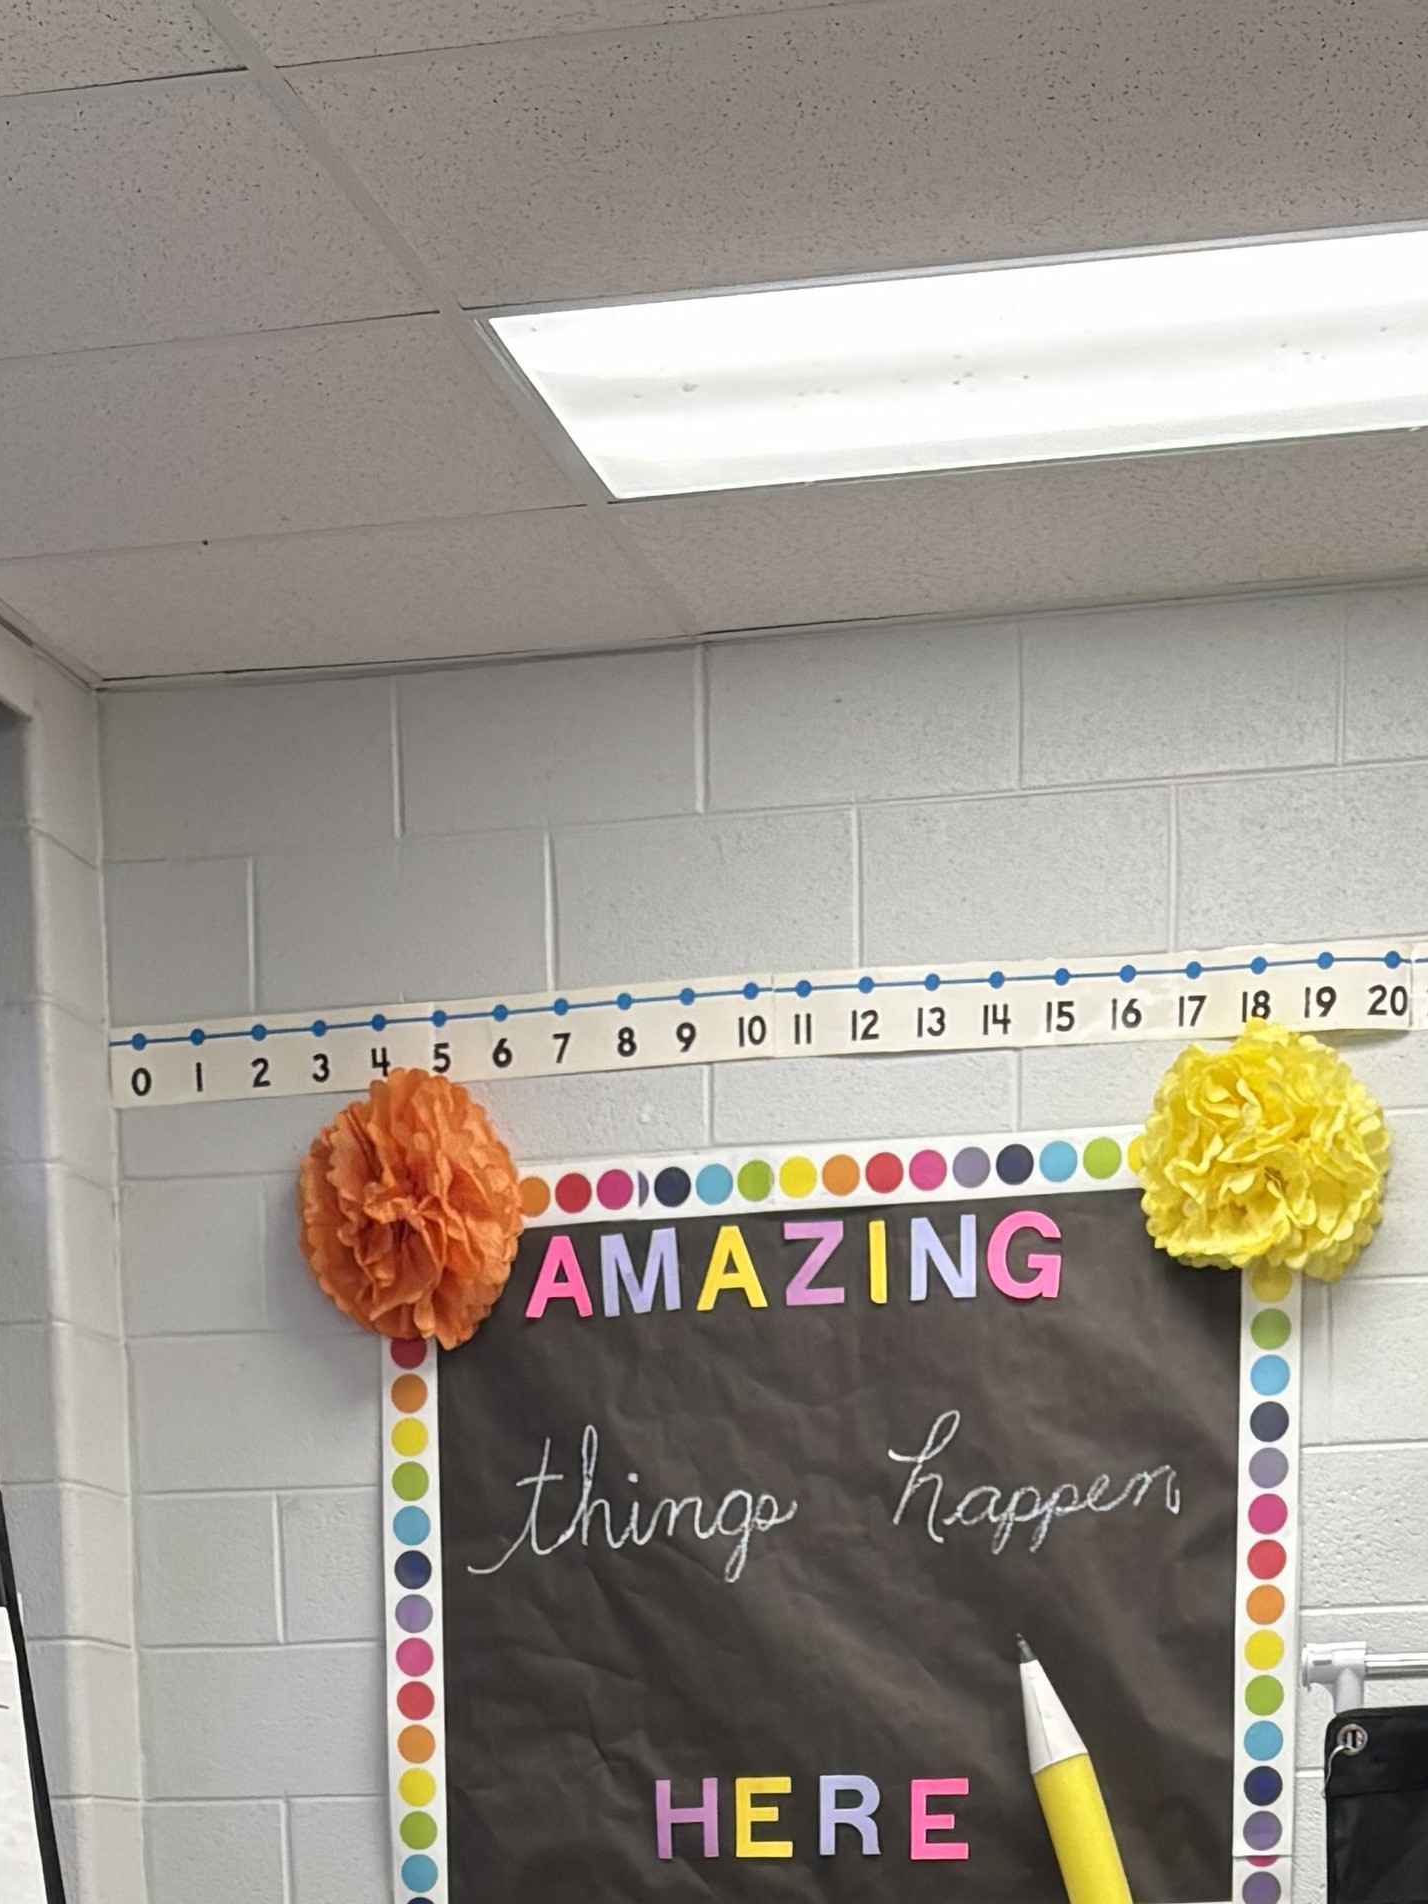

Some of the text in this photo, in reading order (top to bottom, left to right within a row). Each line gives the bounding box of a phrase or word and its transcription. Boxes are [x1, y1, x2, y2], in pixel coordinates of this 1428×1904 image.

[131, 1068, 151, 1096] 0
[196, 1062, 203, 1092] 1
[251, 1058, 270, 1087] 2
[312, 1053, 329, 1082] 3
[371, 1047, 390, 1077] 4
[433, 1042, 452, 1073] 5
[493, 1038, 512, 1068] 6
[553, 1033, 570, 1063] 7
[618, 1027, 636, 1057] 8
[677, 1023, 695, 1052] 9
[739, 1016, 766, 1046] 10
[795, 1014, 811, 1044] 11
[852, 1010, 878, 1040] 12
[918, 1008, 945, 1036] 13
[984, 1005, 1010, 1034] 14
[1047, 1001, 1074, 1031] 15
[1113, 999, 1141, 1027] 16
[1180, 996, 1206, 1026] 17
[1243, 991, 1270, 1022] 18
[1305, 987, 1336, 1017] 19
[1368, 985, 1407, 1015] 20
[524, 1210, 1064, 1319] AMAZING
[466, 1408, 1181, 1583] things happen
[654, 1774, 970, 1860] HERE
